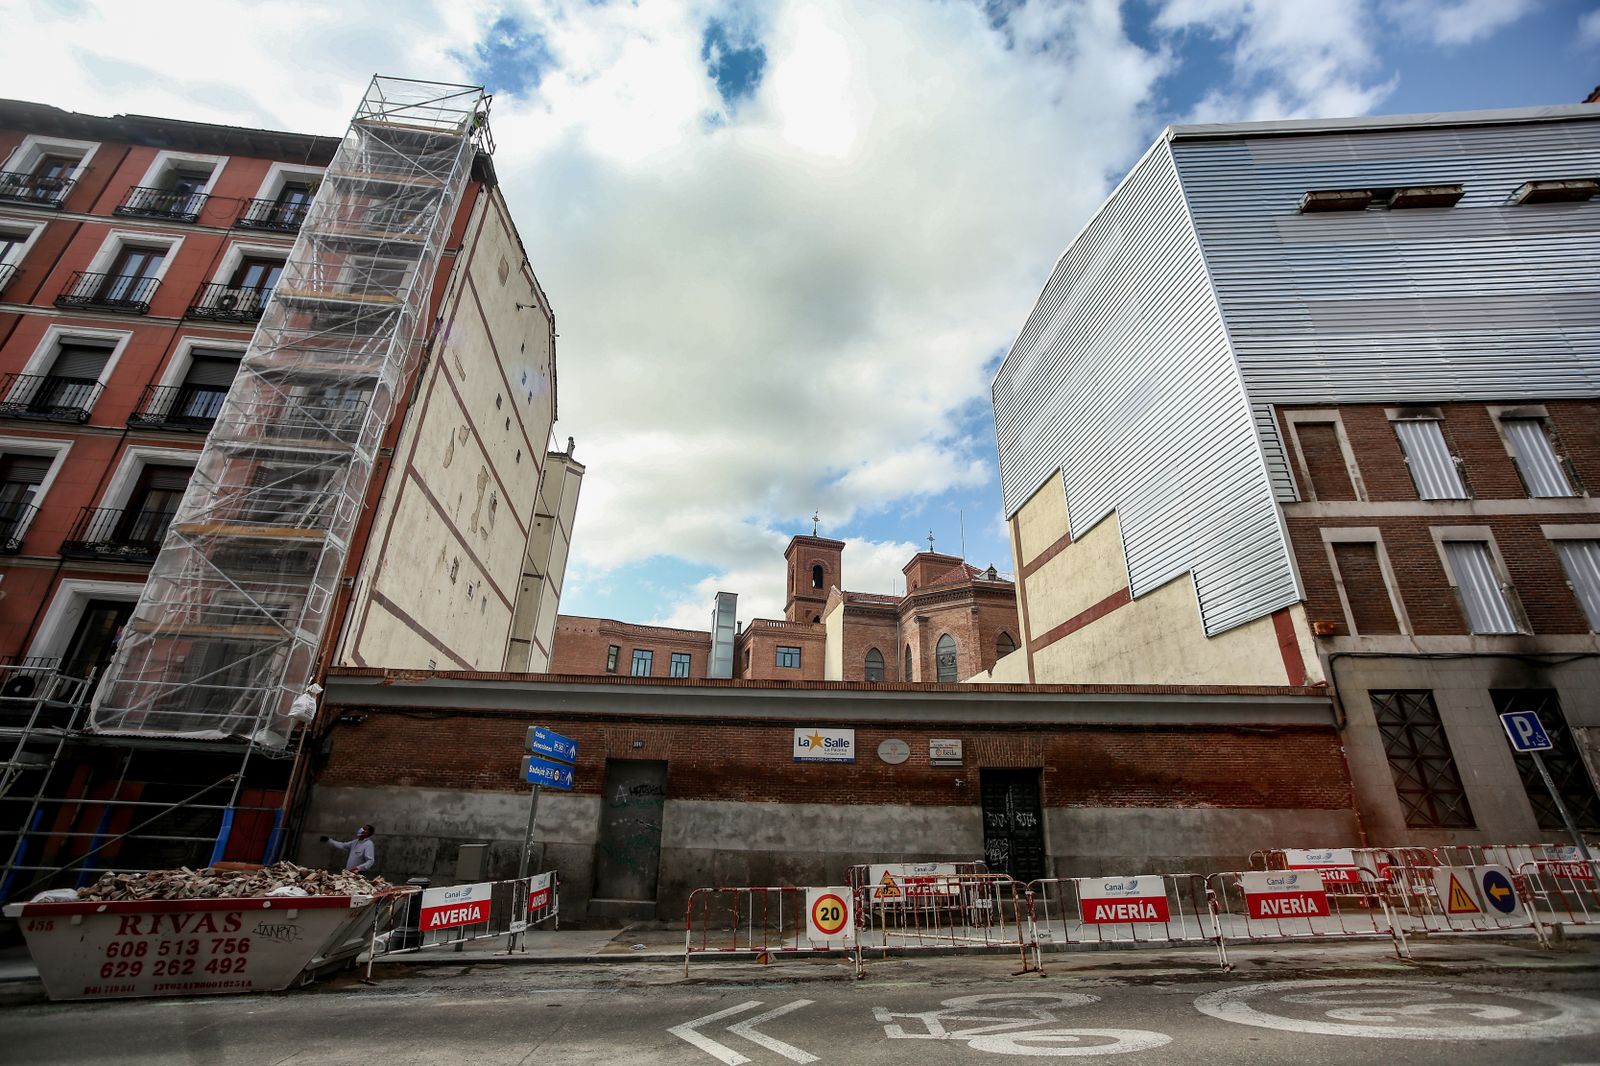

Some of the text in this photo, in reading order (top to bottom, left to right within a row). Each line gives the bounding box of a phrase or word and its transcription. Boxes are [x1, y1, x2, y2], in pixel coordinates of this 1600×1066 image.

[1511, 716, 1533, 746] P
[798, 736, 850, 748] La Salle
[1104, 882, 1124, 891] Canal
[1266, 877, 1284, 886] Canal
[444, 890, 460, 899] Canal
[1260, 894, 1319, 915] AVERÍA
[430, 904, 481, 927] AVERÍA
[820, 906, 839, 921] 20
[1095, 899, 1158, 920] AVERÍA
[115, 911, 243, 936] RIVAS
[106, 937, 250, 958] 608 513 756
[100, 957, 247, 978] 629 262 492
